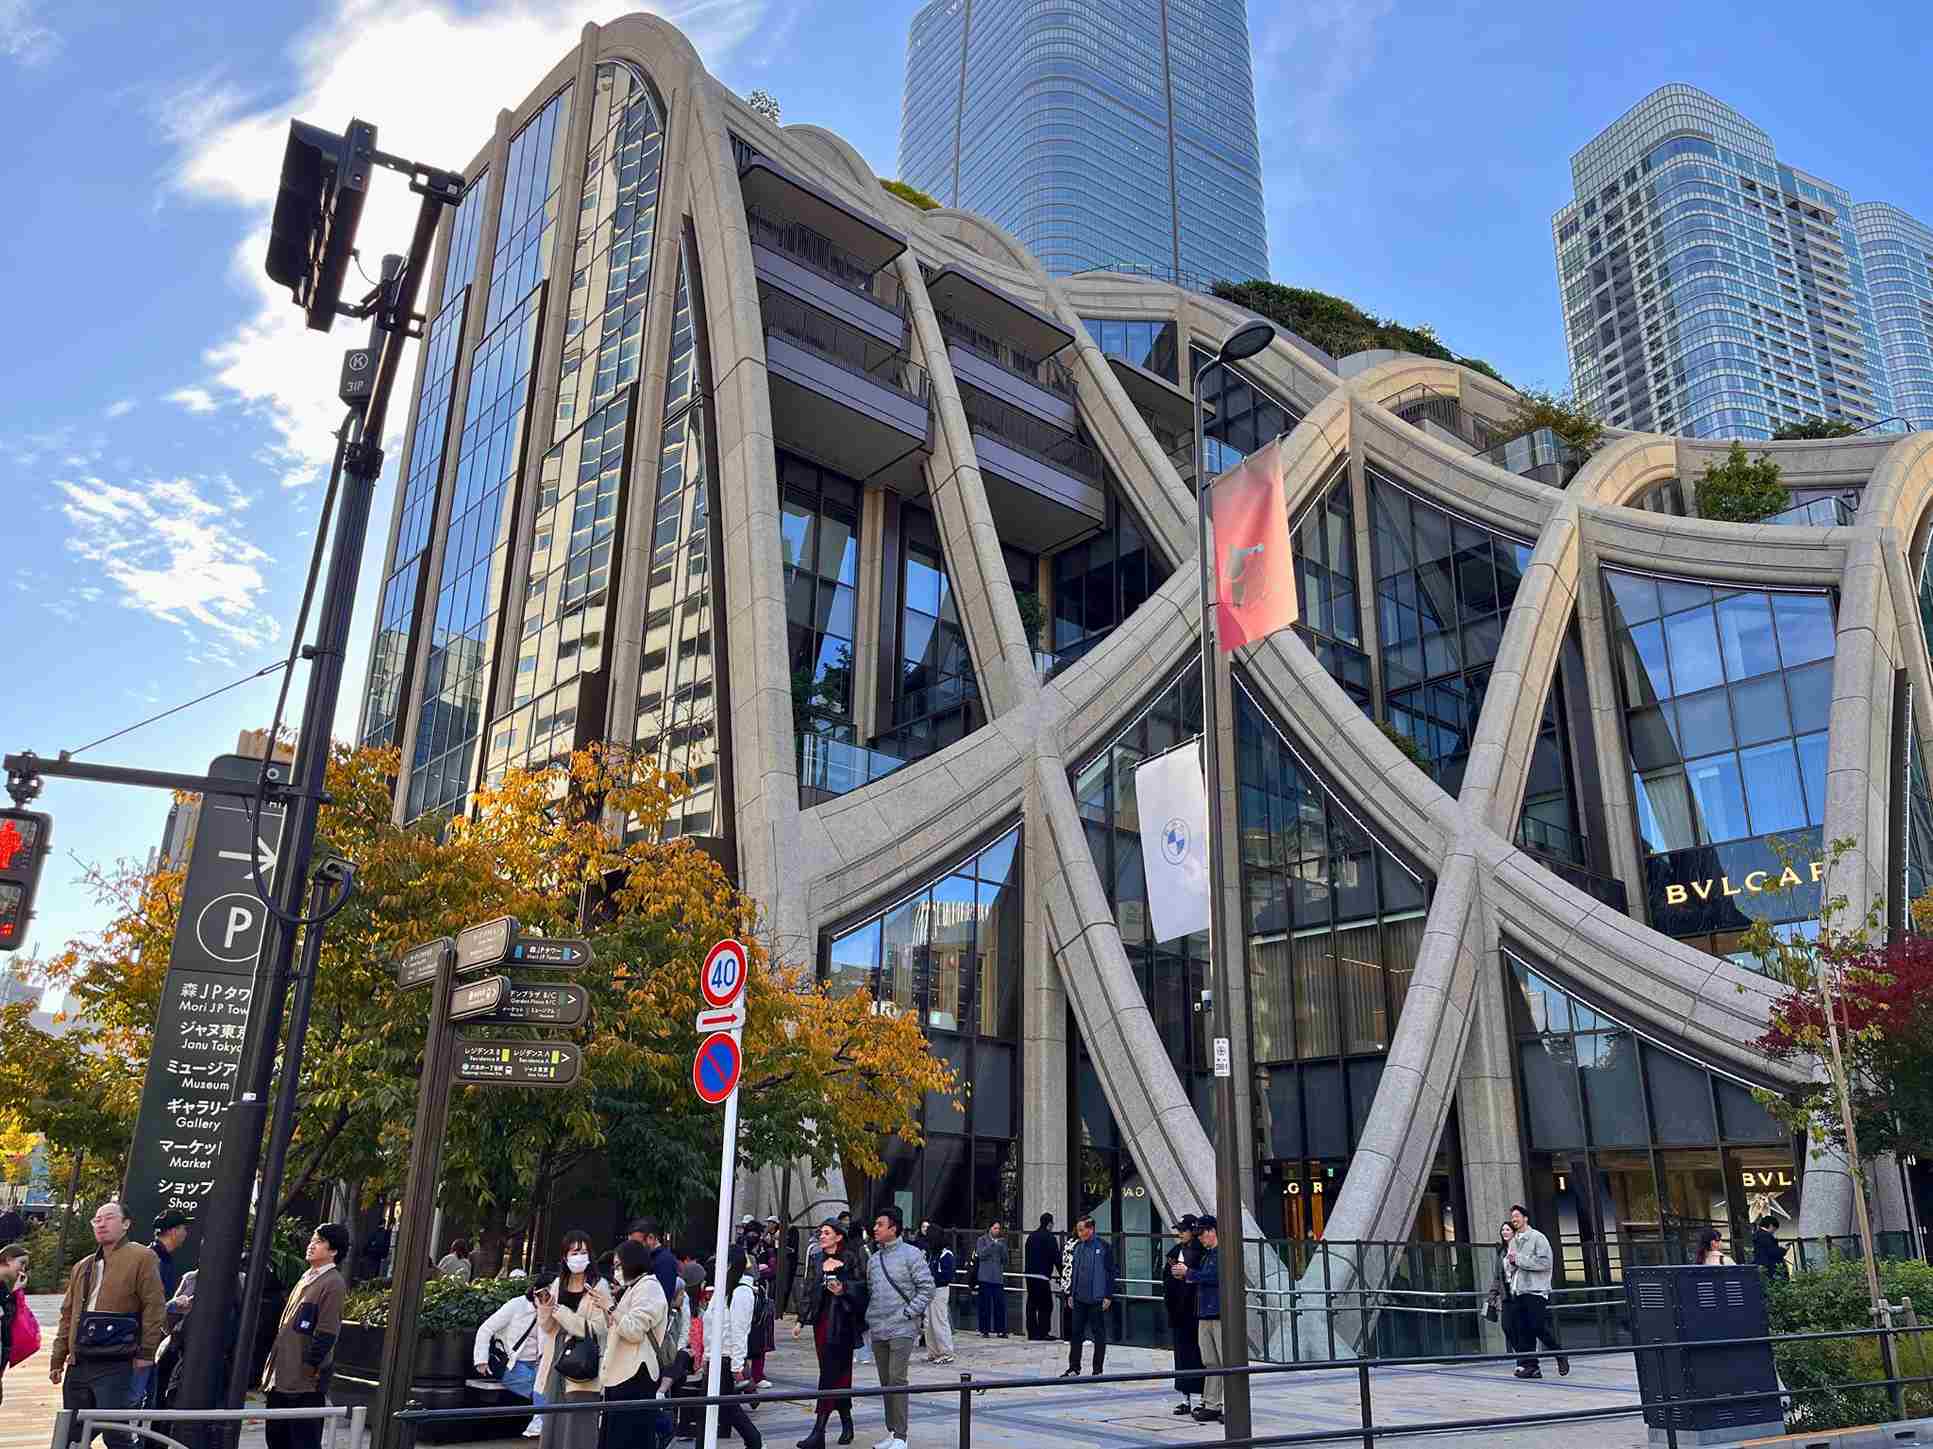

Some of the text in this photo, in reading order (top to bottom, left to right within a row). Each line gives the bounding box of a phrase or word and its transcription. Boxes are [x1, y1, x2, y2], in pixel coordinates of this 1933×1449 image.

[1665, 862, 1824, 905] BVLGAR
[224, 906, 253, 949] P
[711, 958, 736, 989] 40
[180, 982, 251, 1001] 森JPタワ
[179, 1000, 249, 1015] Mori JP Tow
[182, 1038, 208, 1050] Janu
[167, 1059, 237, 1077] ミュージア
[182, 1078, 230, 1091] Museum
[176, 1116, 222, 1132] Gallery
[169, 1156, 213, 1169] Market
[1742, 1170, 1797, 1187] BVL
[158, 1179, 215, 1196] ショップ
[168, 1197, 198, 1211] Shop
